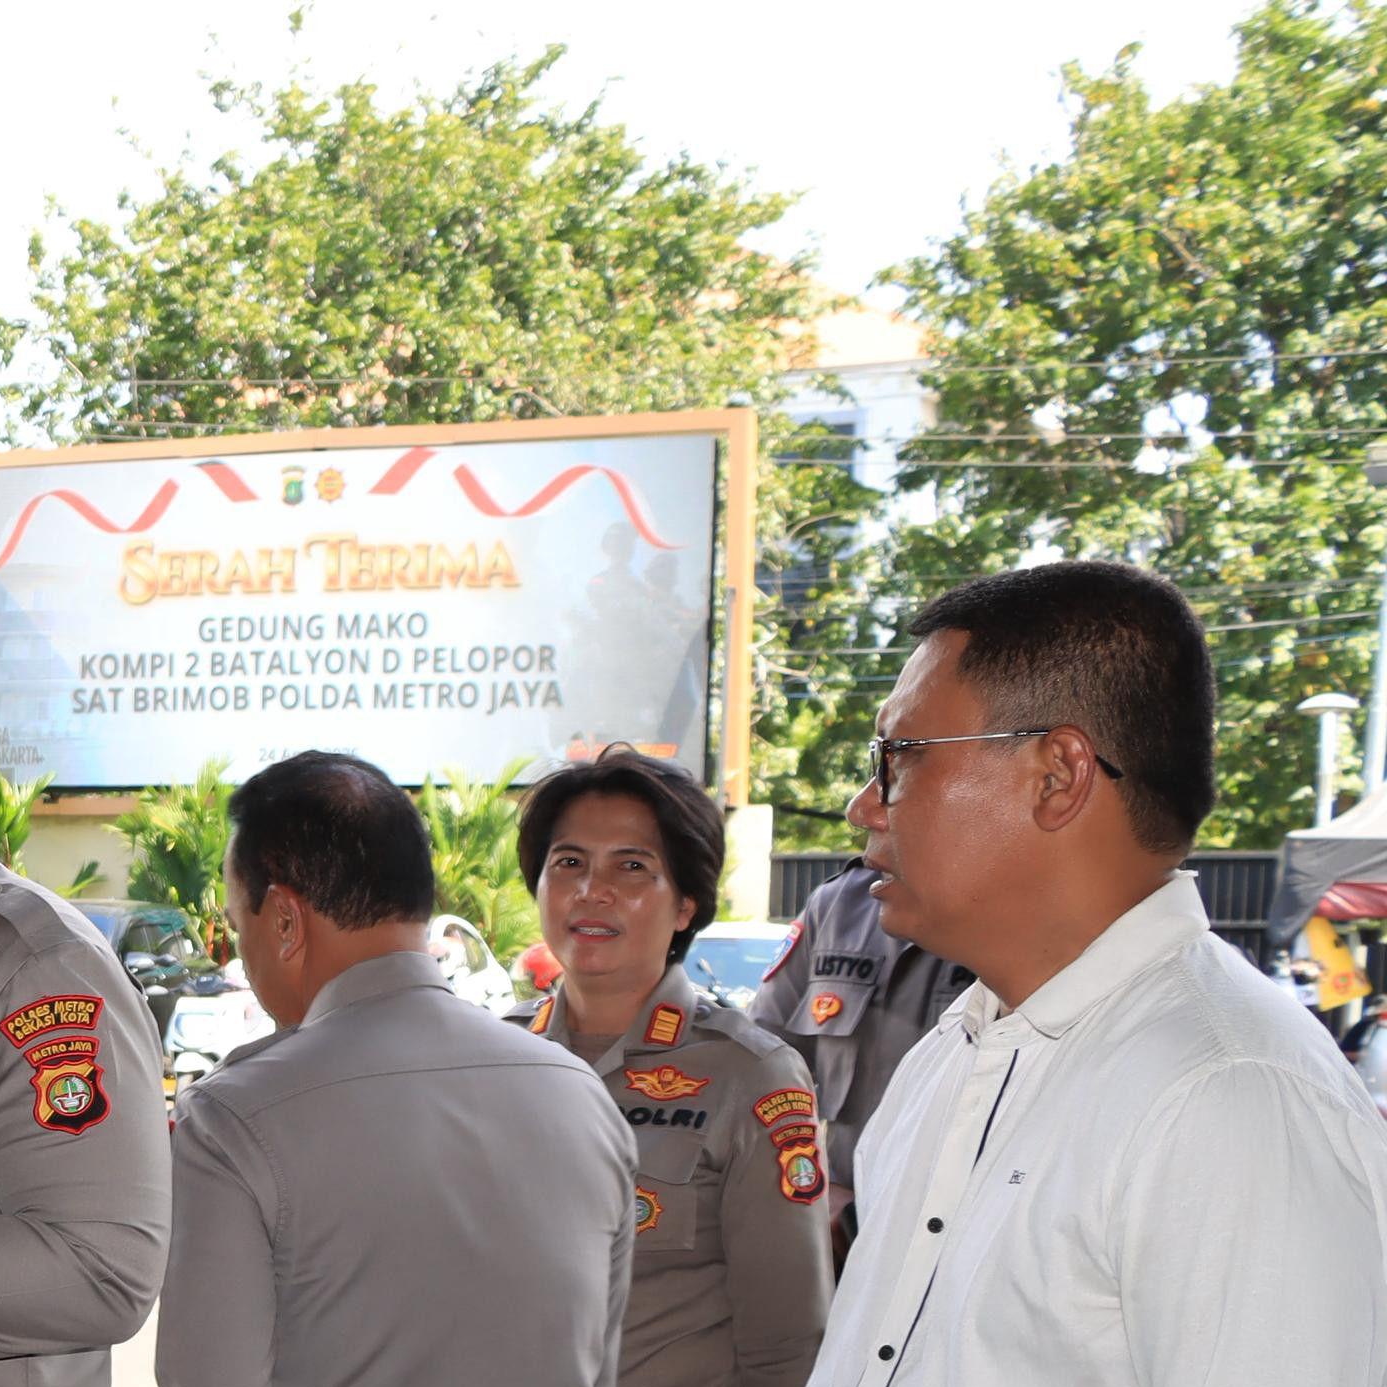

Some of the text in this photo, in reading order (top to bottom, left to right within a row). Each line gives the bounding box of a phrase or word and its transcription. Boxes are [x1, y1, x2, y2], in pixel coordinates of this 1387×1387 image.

[119, 533, 521, 606] SERAH TERIMA
[198, 612, 429, 643] GEDUNG MAKO
[80, 645, 558, 681] KOMPI 2 BATALYON D PELOPOR
[72, 680, 565, 716] SAT BRIMOB POLDA METRO JAYA
[814, 955, 874, 979] LISTYO
[7, 1000, 96, 1034] POLRES METRO
[15, 1012, 91, 1040] BEKASI KOTA
[31, 1041, 93, 1062] METRO JAYA
